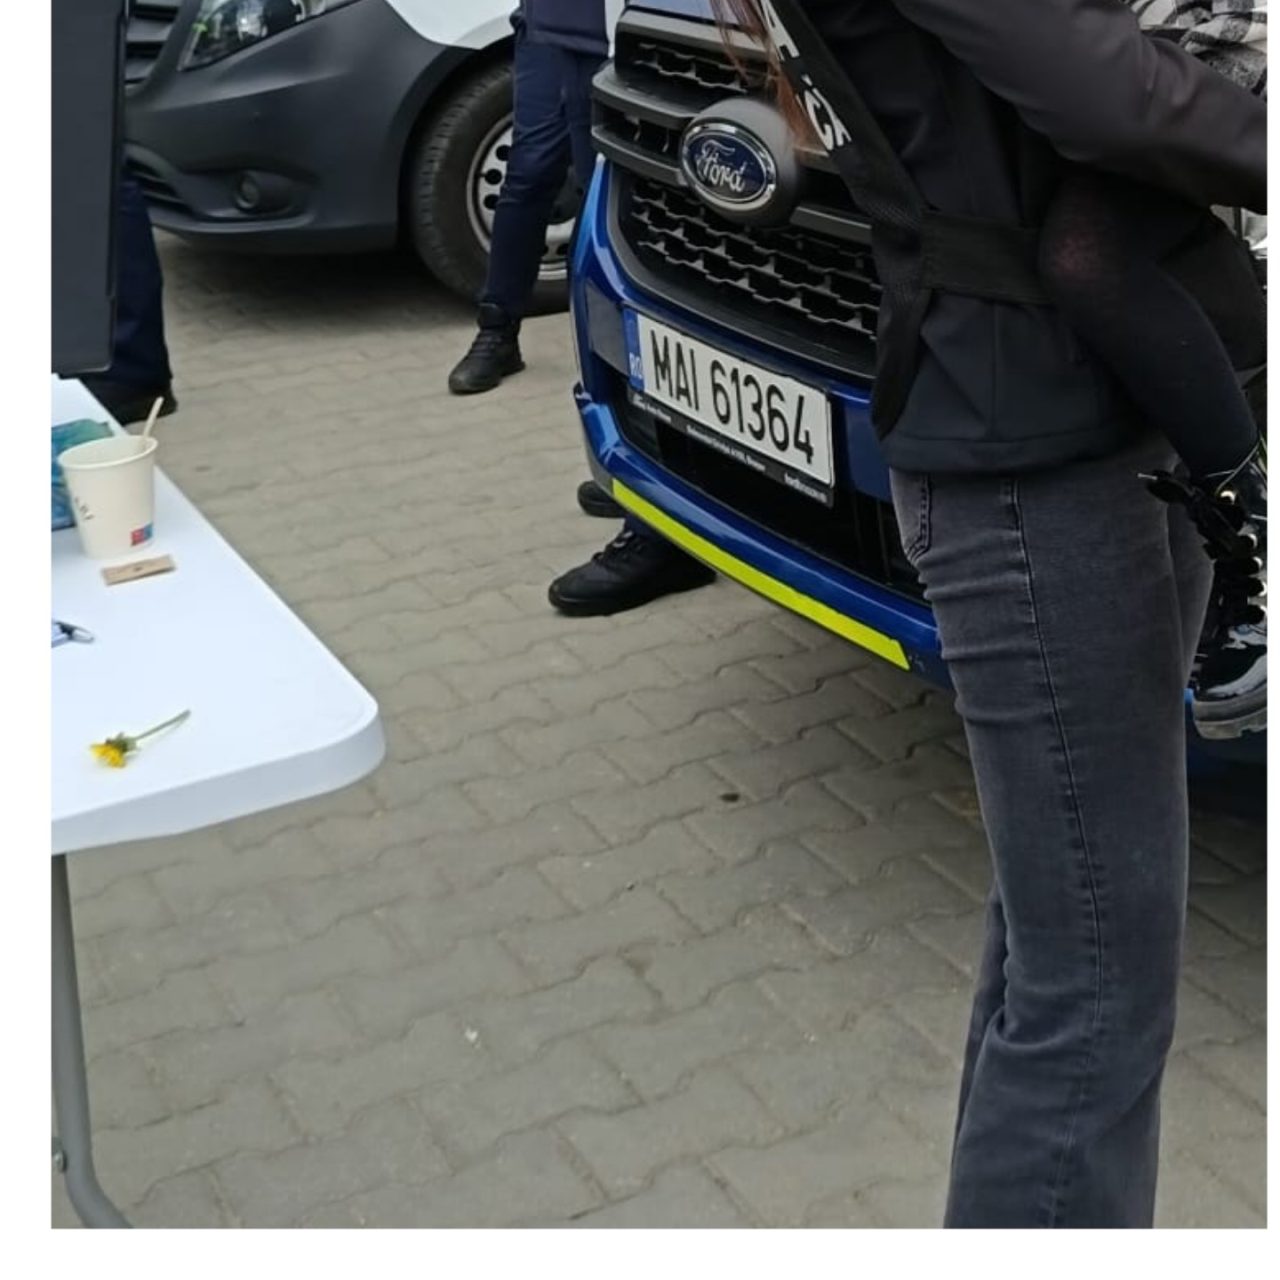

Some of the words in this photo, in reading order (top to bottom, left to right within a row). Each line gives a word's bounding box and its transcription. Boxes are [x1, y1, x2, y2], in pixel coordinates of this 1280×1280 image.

[694, 140, 747, 192] Ford
[651, 329, 699, 411] MAI
[710, 359, 814, 464] 61364
